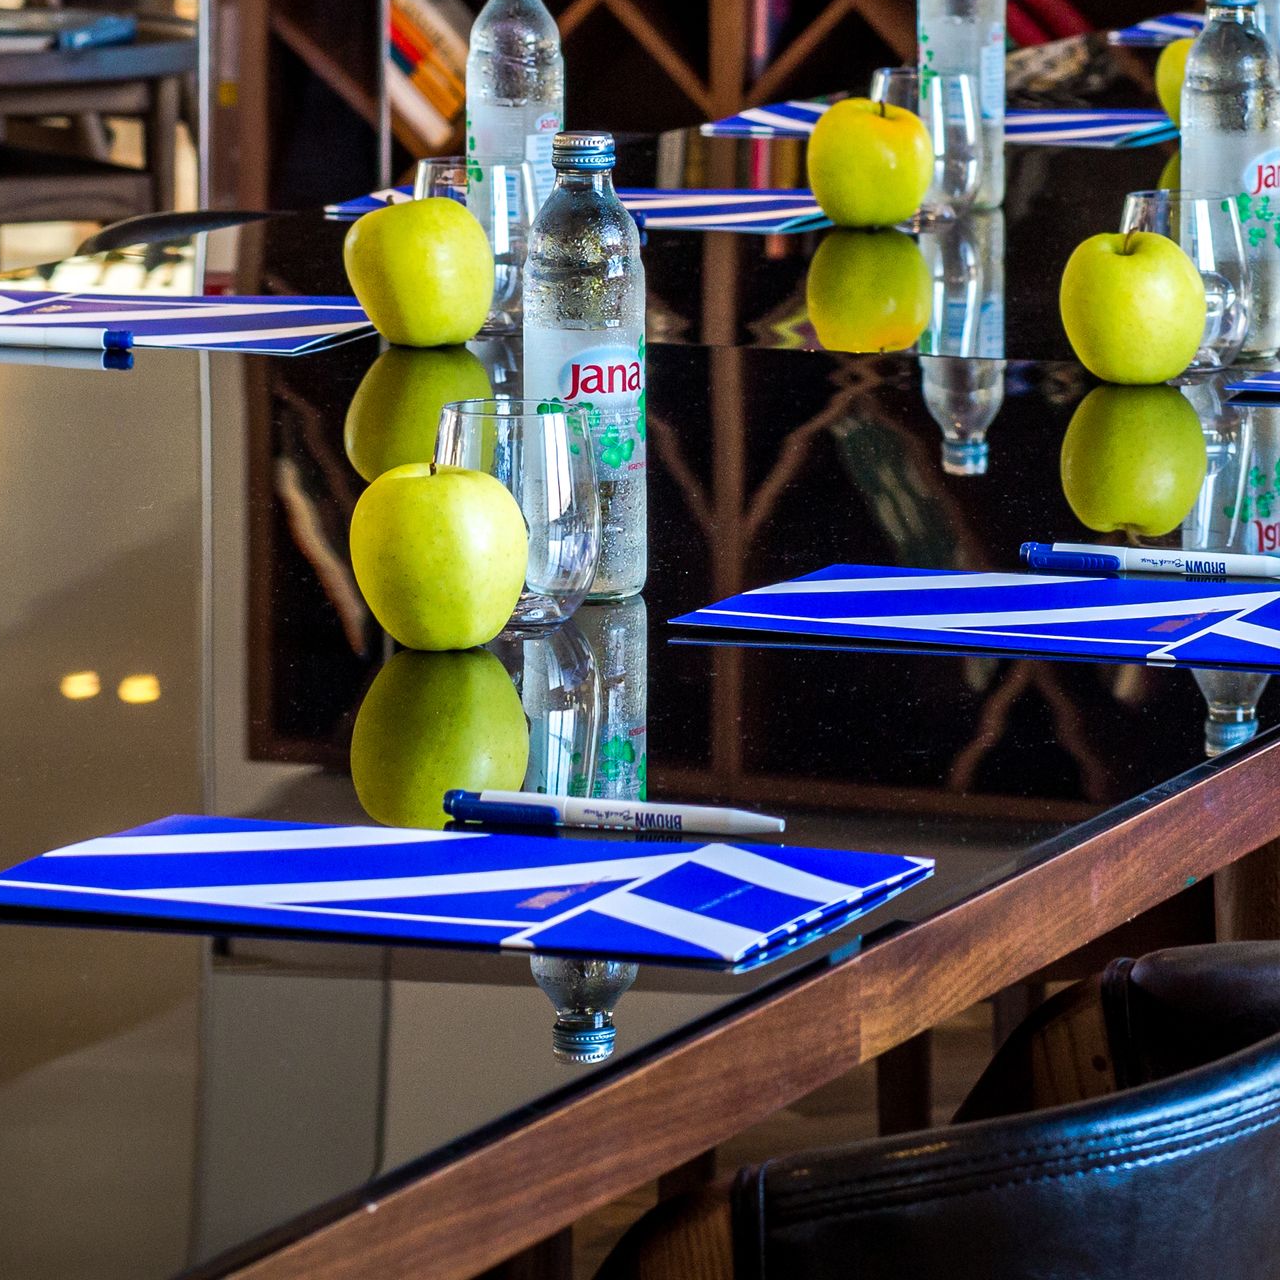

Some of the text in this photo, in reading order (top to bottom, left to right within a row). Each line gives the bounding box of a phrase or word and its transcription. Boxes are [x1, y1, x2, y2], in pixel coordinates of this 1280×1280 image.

[564, 361, 642, 400] Jana
[1185, 560, 1227, 574] BROWN
[635, 812, 683, 831] BROWN
